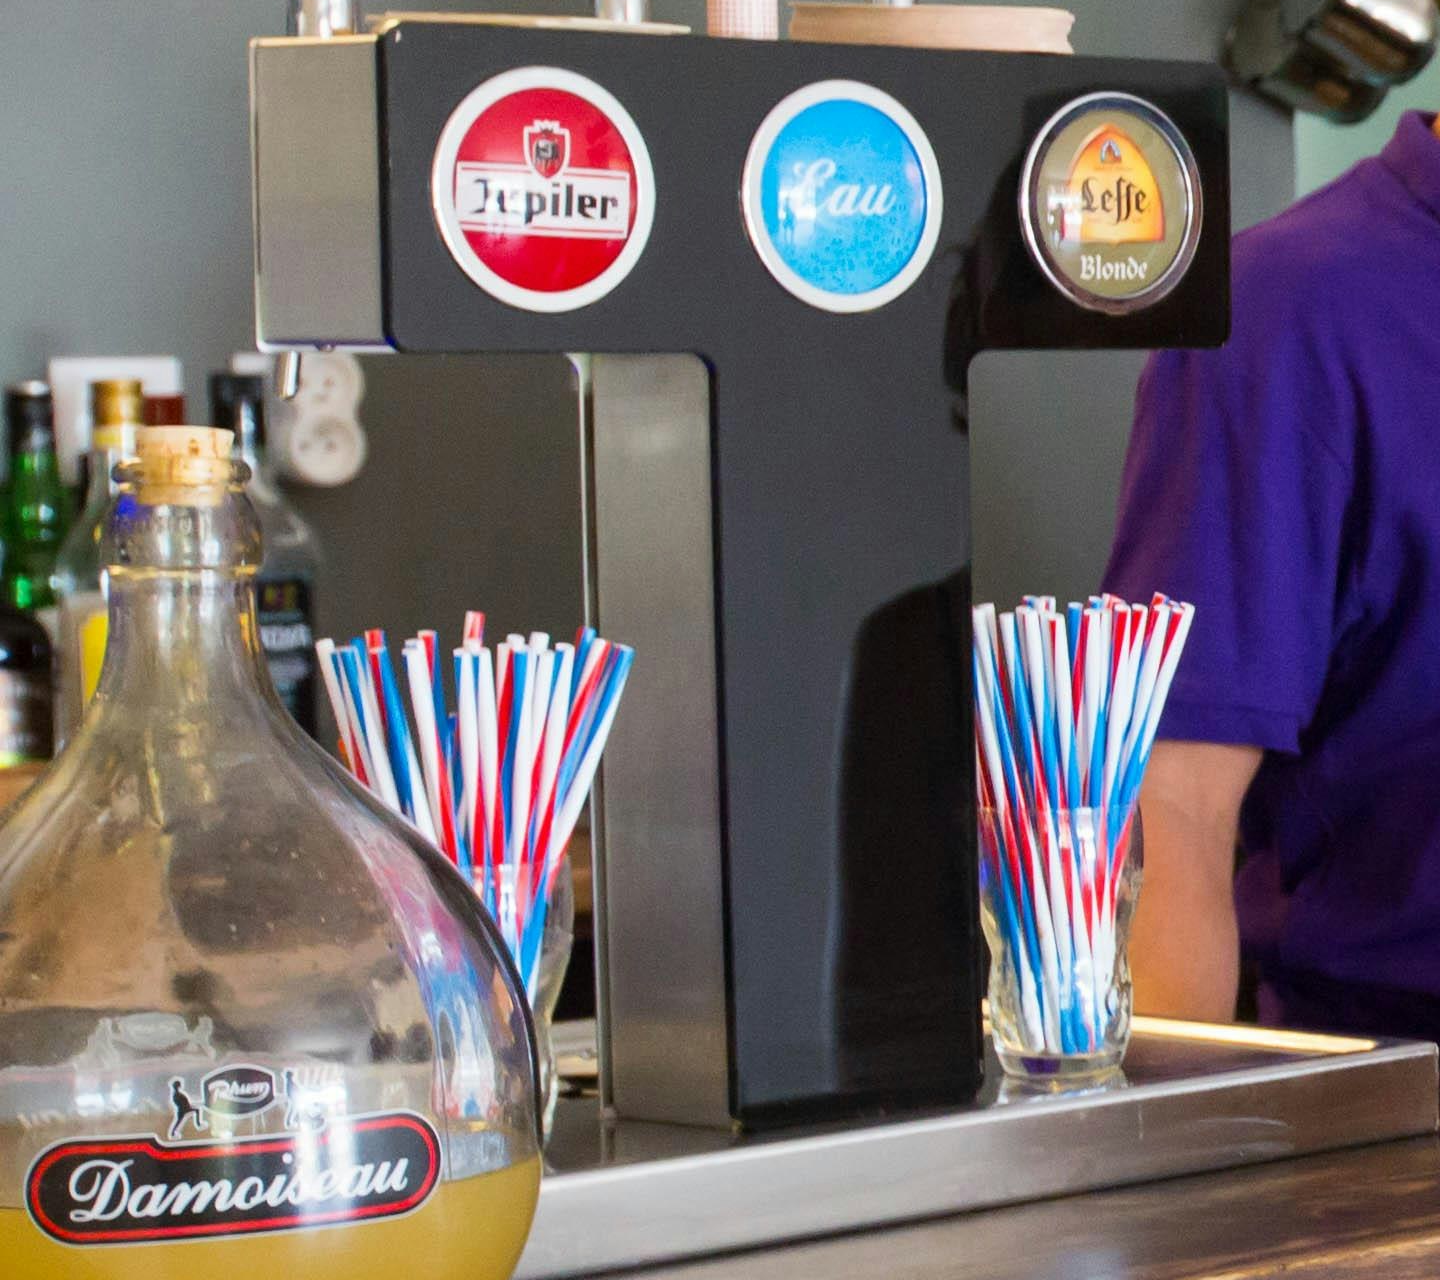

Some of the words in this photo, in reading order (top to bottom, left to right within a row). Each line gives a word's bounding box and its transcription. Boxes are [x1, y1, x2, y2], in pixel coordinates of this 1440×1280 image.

[790, 158, 897, 218] Eau
[1081, 175, 1149, 225] Leffe
[1079, 254, 1149, 281] Blonde
[207, 1079, 271, 1104] Rhum
[69, 1153, 409, 1223] Damoiseau
